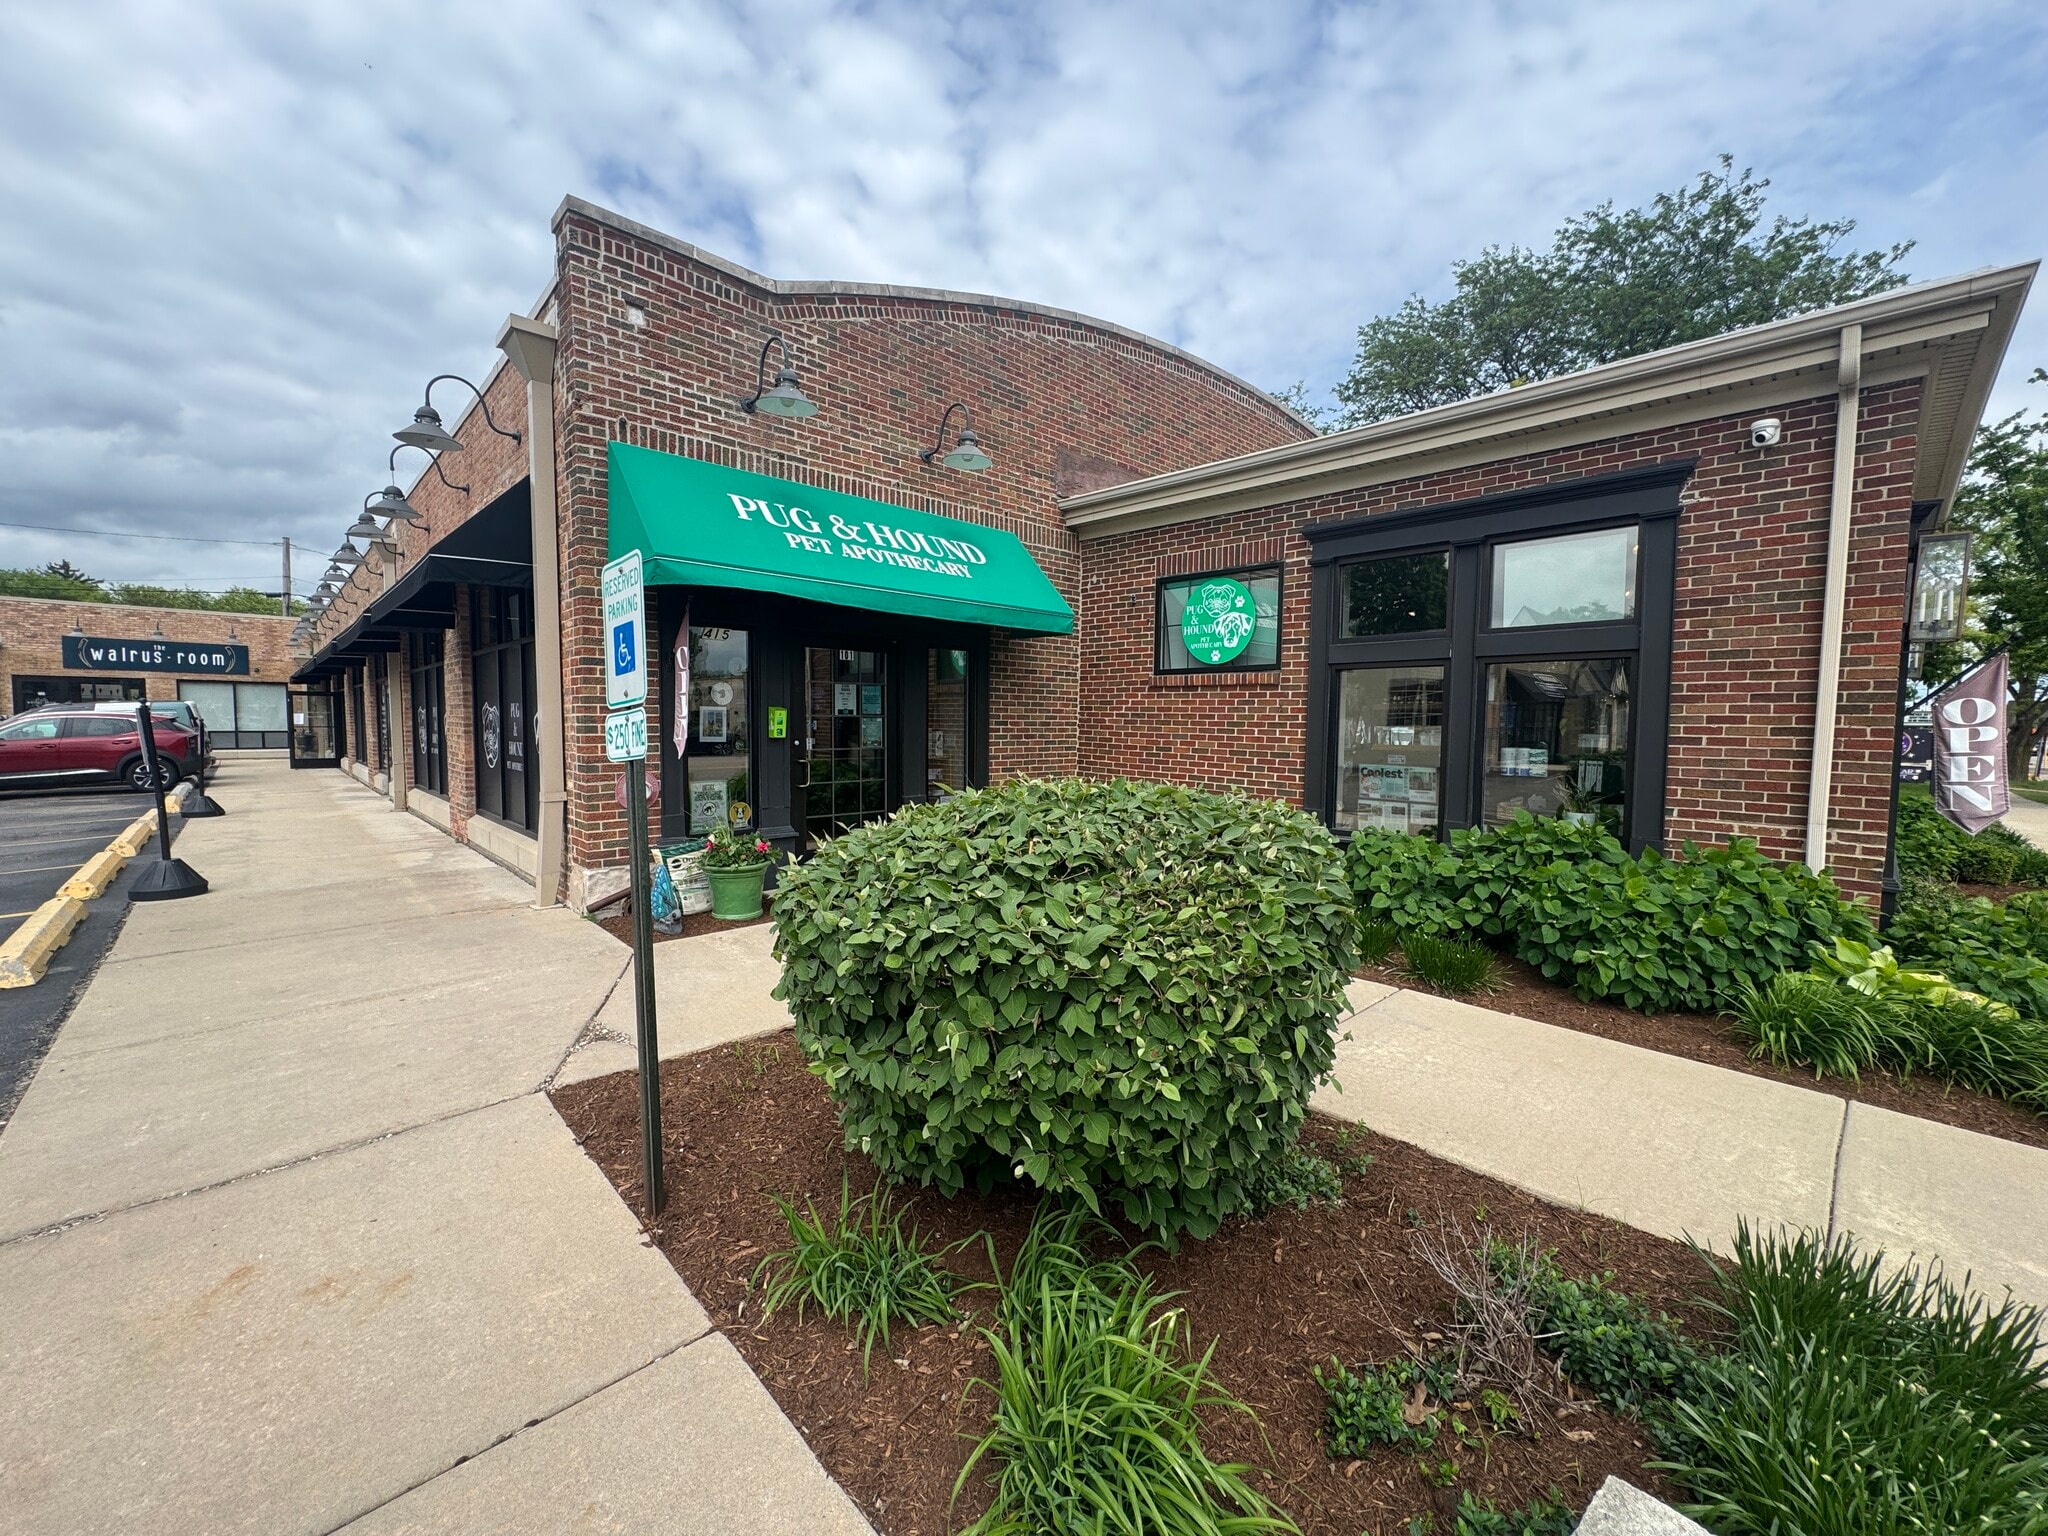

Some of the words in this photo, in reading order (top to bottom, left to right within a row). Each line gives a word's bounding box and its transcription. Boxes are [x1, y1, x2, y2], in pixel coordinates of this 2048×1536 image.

[727, 493, 823, 534] PUG
[829, 514, 868, 543] &
[863, 521, 987, 565] HOUND
[783, 531, 834, 555] PET
[842, 542, 974, 579] APOTHECARY
[604, 568, 639, 598] RESERVED
[607, 593, 638, 622] PARKING
[1186, 604, 1204, 616] PUG
[1190, 614, 1199, 625] &
[703, 628, 730, 640] 415
[1183, 624, 1214, 636] HOUND
[90, 647, 162, 664] walrus
[177, 651, 225, 666] room
[840, 650, 854, 661] 101
[607, 722, 629, 750] $250
[631, 719, 645, 748] FINE
[1941, 697, 1999, 812] OPEN
[1360, 766, 1404, 779] Coolest
